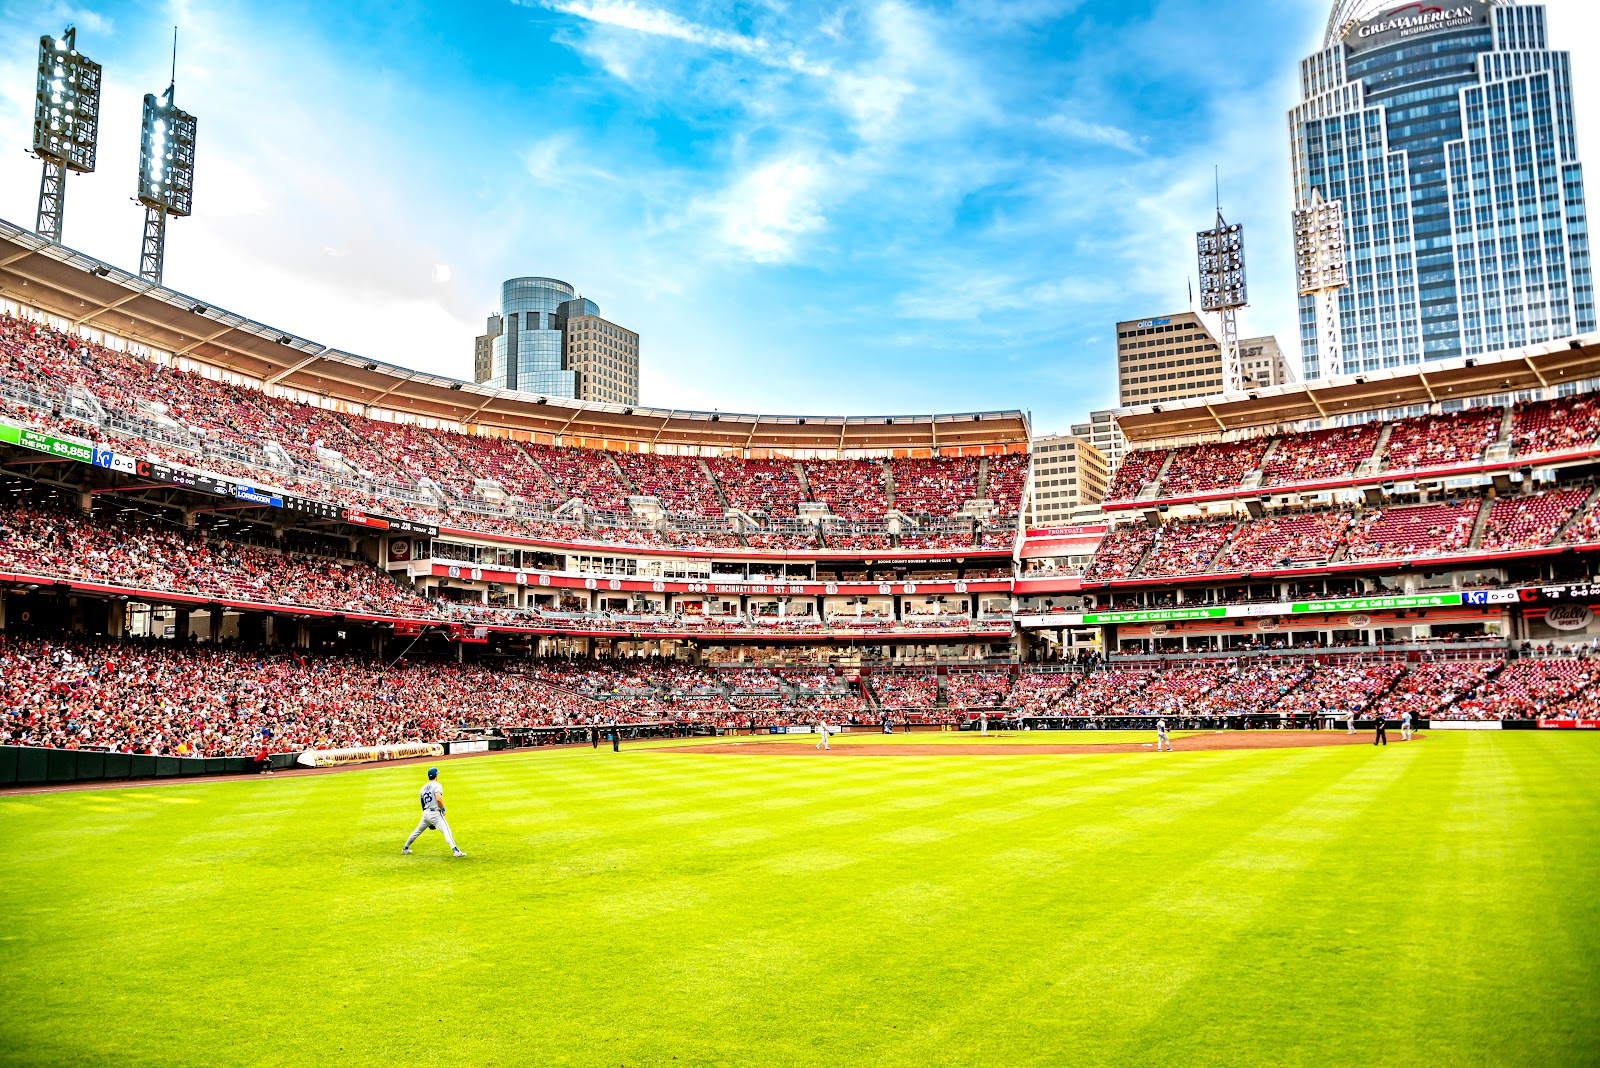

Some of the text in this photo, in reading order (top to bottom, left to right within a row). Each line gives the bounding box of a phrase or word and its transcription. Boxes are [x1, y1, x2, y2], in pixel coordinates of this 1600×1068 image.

[1400, 16, 1473, 37] INSURANCE GROUP
[1239, 345, 1263, 357] RST
[25, 432, 46, 442] SPLIT
[20, 438, 51, 451] THE POT
[53, 442, 90, 459] $8,855
[95, 448, 109, 468] KC
[238, 491, 271, 504] LORENZEN
[714, 584, 750, 593] CINCINNATI
[752, 585, 768, 593] REDS
[773, 585, 788, 593] EST.
[1549, 607, 1588, 622] Bally
